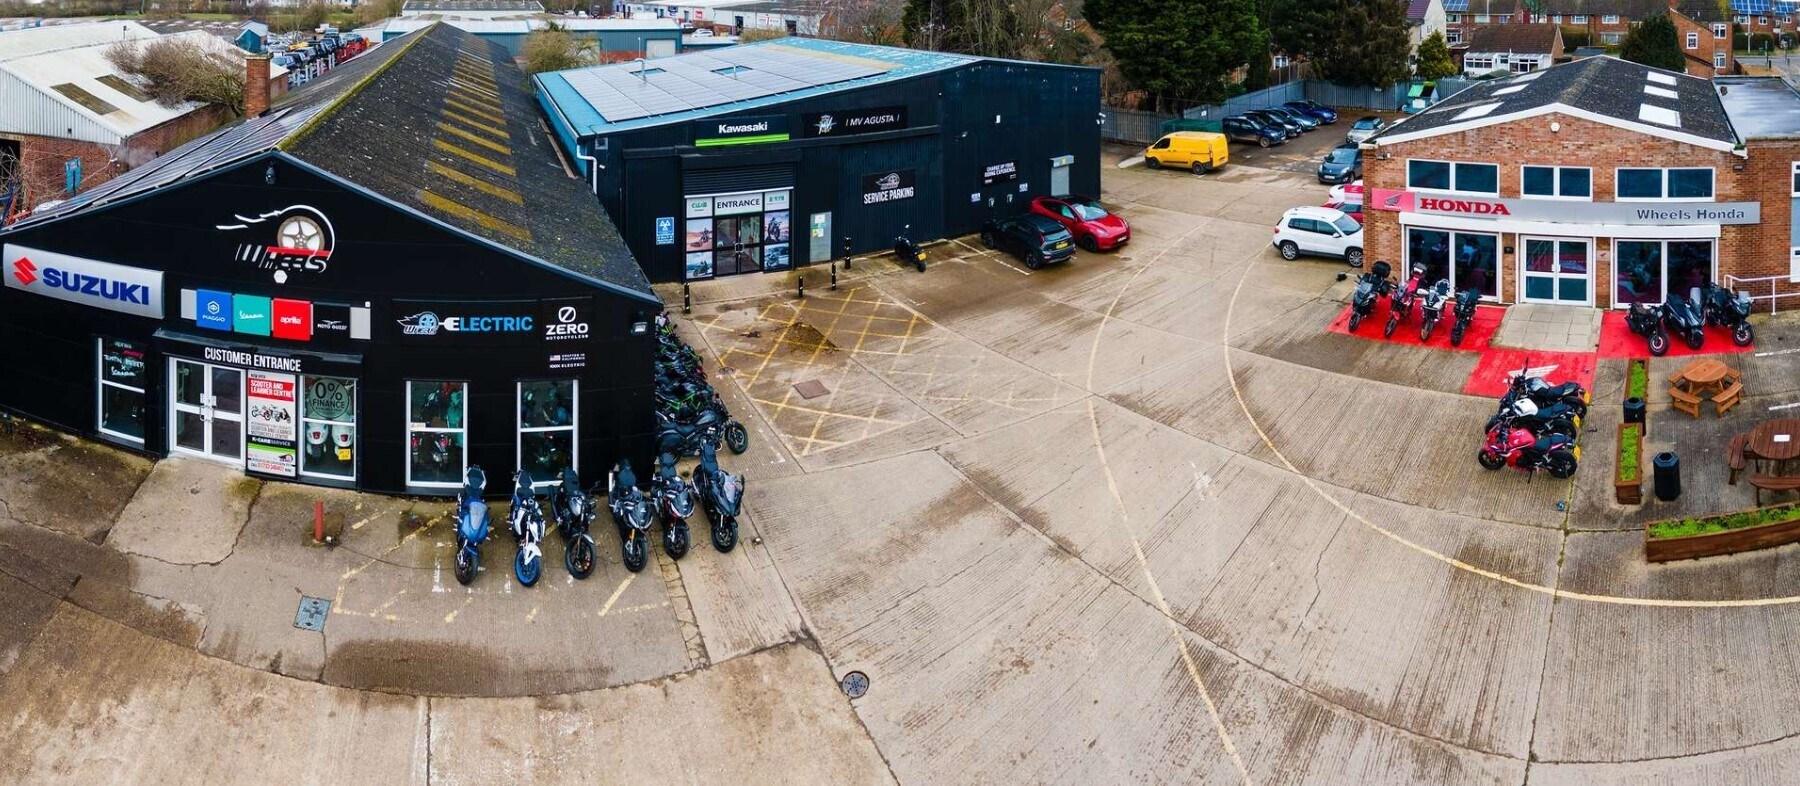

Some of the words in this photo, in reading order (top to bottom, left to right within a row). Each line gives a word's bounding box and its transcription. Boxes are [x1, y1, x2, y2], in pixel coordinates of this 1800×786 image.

[850, 117, 863, 126] MV
[863, 115, 894, 124] AGUSTA
[718, 121, 768, 134] Kawasaki
[863, 190, 889, 204] SERVICE
[889, 186, 914, 200] PARKING
[717, 198, 760, 209] ENTRANCE
[1420, 198, 1511, 215] HONDA
[1637, 209, 1691, 220] Wheels
[1697, 208, 1745, 219] Honda
[42, 267, 149, 305] SUZUKI
[202, 315, 226, 323] PIAGGIO
[280, 315, 302, 325] aprilia
[444, 316, 533, 331] ELECTRIC
[546, 323, 589, 336] ZERO
[204, 346, 252, 366] CUSTOMER
[253, 354, 302, 372] ENTRANCE
[273, 389, 293, 397] CENTRE
[315, 381, 343, 400] 0%
[312, 398, 345, 409] FINANCE
